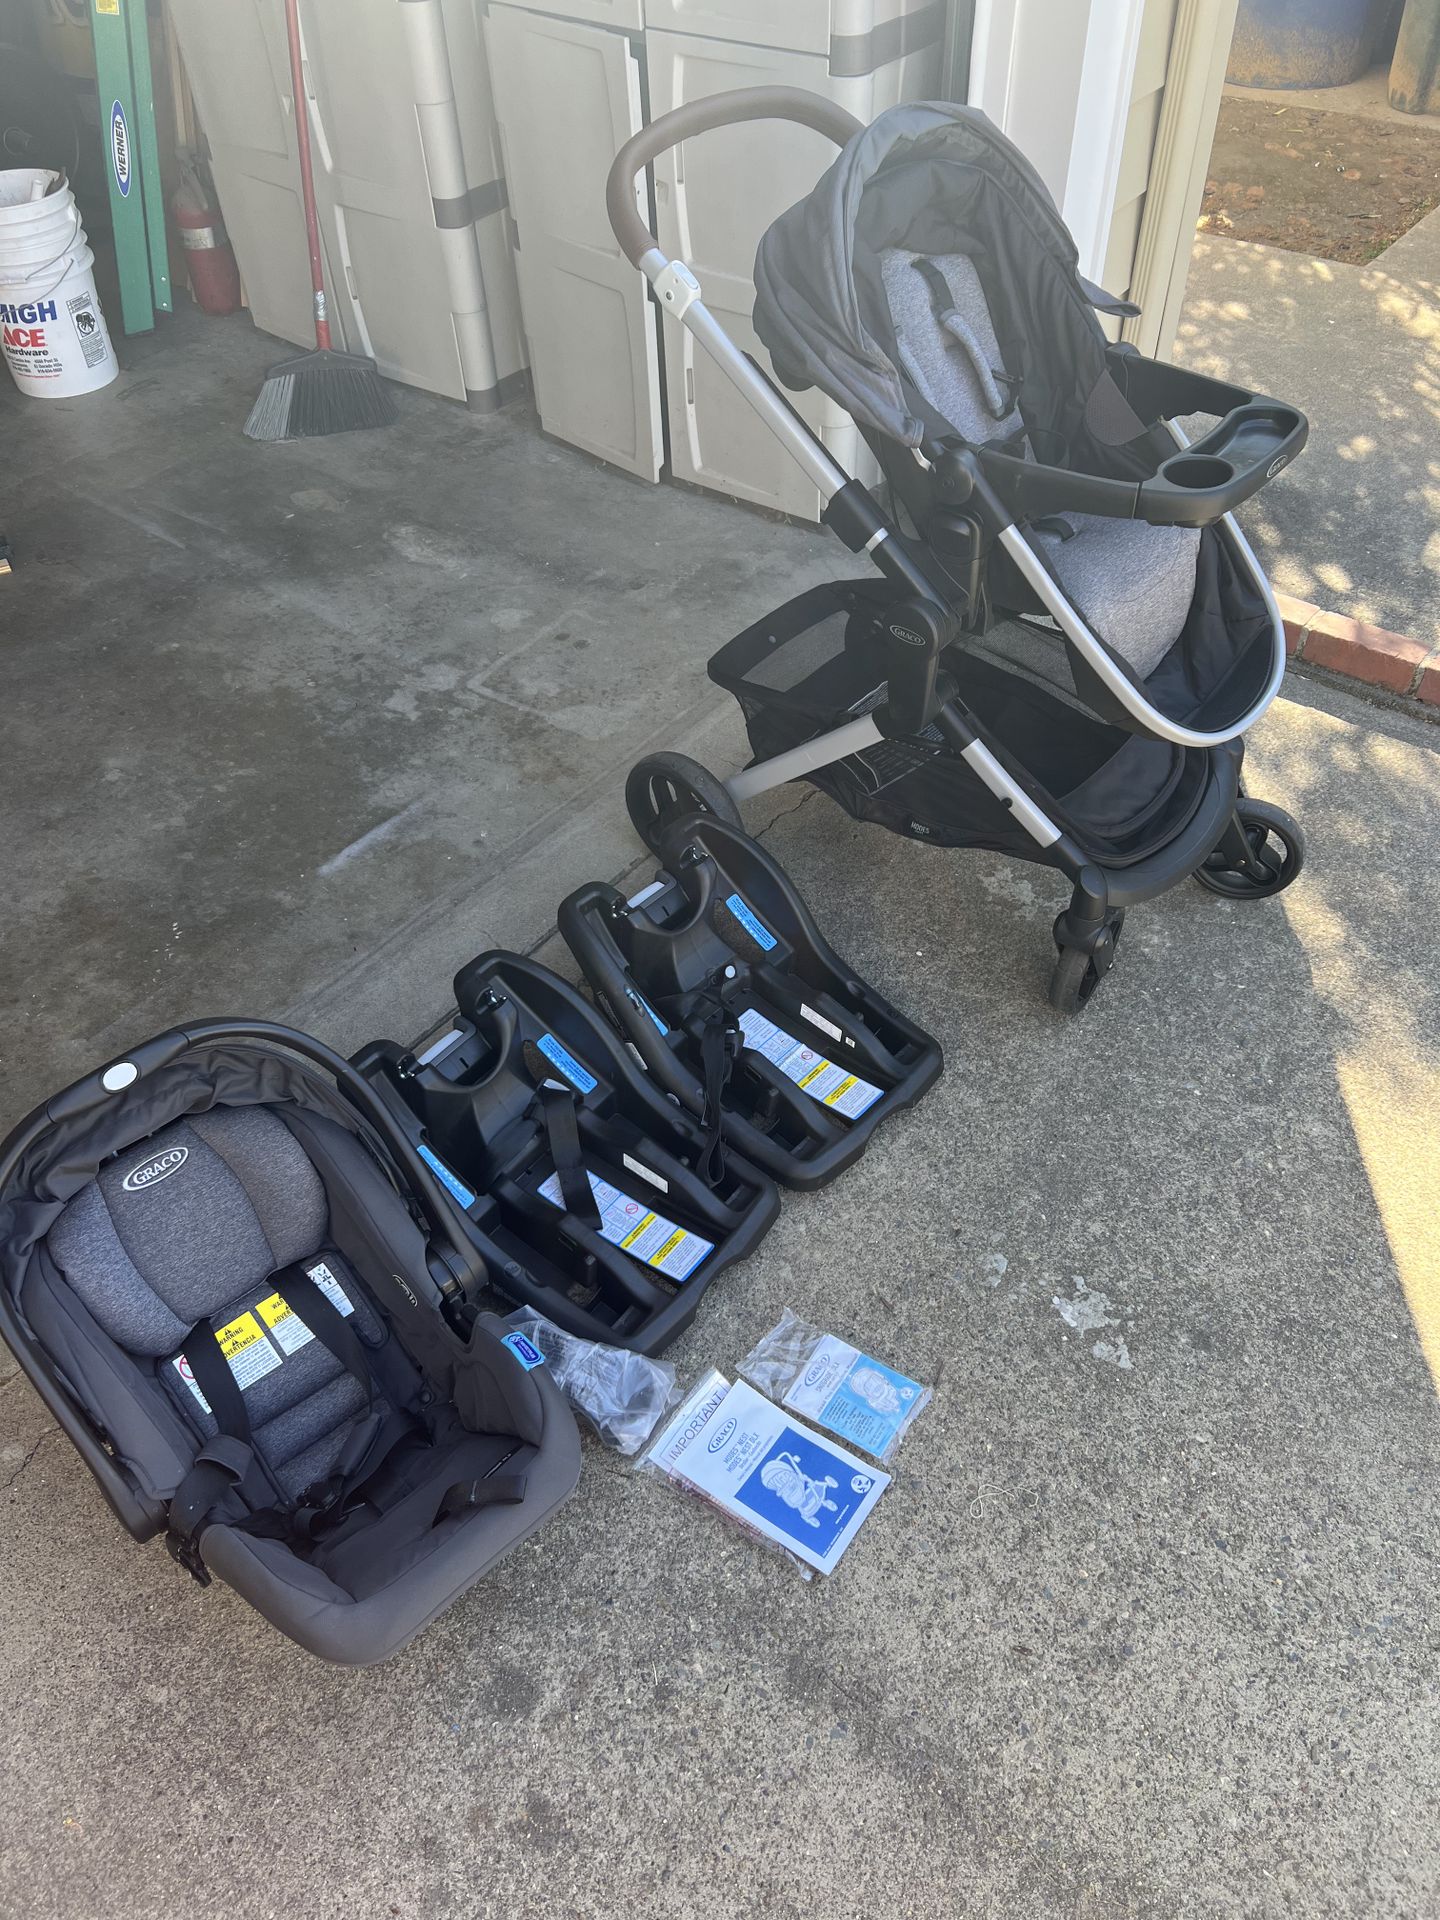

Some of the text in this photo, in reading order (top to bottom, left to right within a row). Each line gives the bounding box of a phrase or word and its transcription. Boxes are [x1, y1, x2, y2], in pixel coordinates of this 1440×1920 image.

[115, 120, 126, 176] WERNER
[3, 324, 47, 348] ACE
[5, 345, 48, 356] Hardware
[894, 628, 921, 644] GRACO
[133, 1151, 182, 1184] GRACO
[272, 1298, 285, 1309] WAR
[274, 1310, 292, 1324] ADVER
[224, 1334, 256, 1358] DVERTENCIA
[669, 1390, 722, 1461] IMPORTANT
[711, 1422, 734, 1448] GRACO
